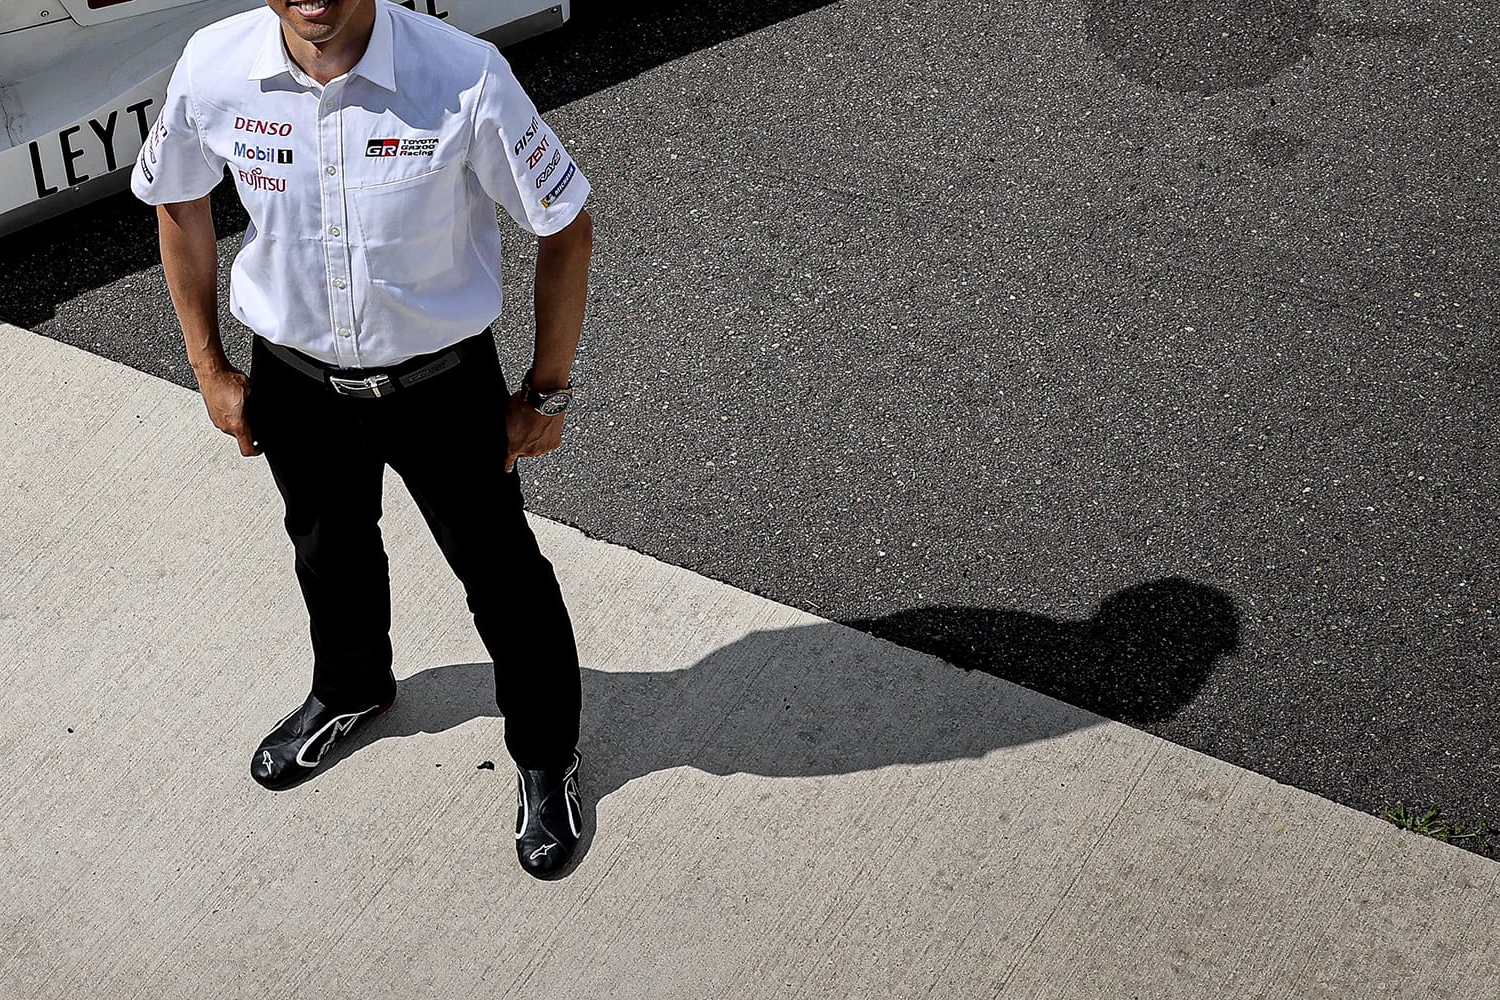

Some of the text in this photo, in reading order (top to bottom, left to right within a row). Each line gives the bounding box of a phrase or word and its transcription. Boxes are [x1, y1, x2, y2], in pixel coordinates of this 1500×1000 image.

[234, 116, 293, 137] DENSO
[28, 98, 153, 199] LEYT
[233, 141, 275, 163] Mobil
[526, 134, 549, 170] ZENT
[238, 167, 287, 192] FUJITSU
